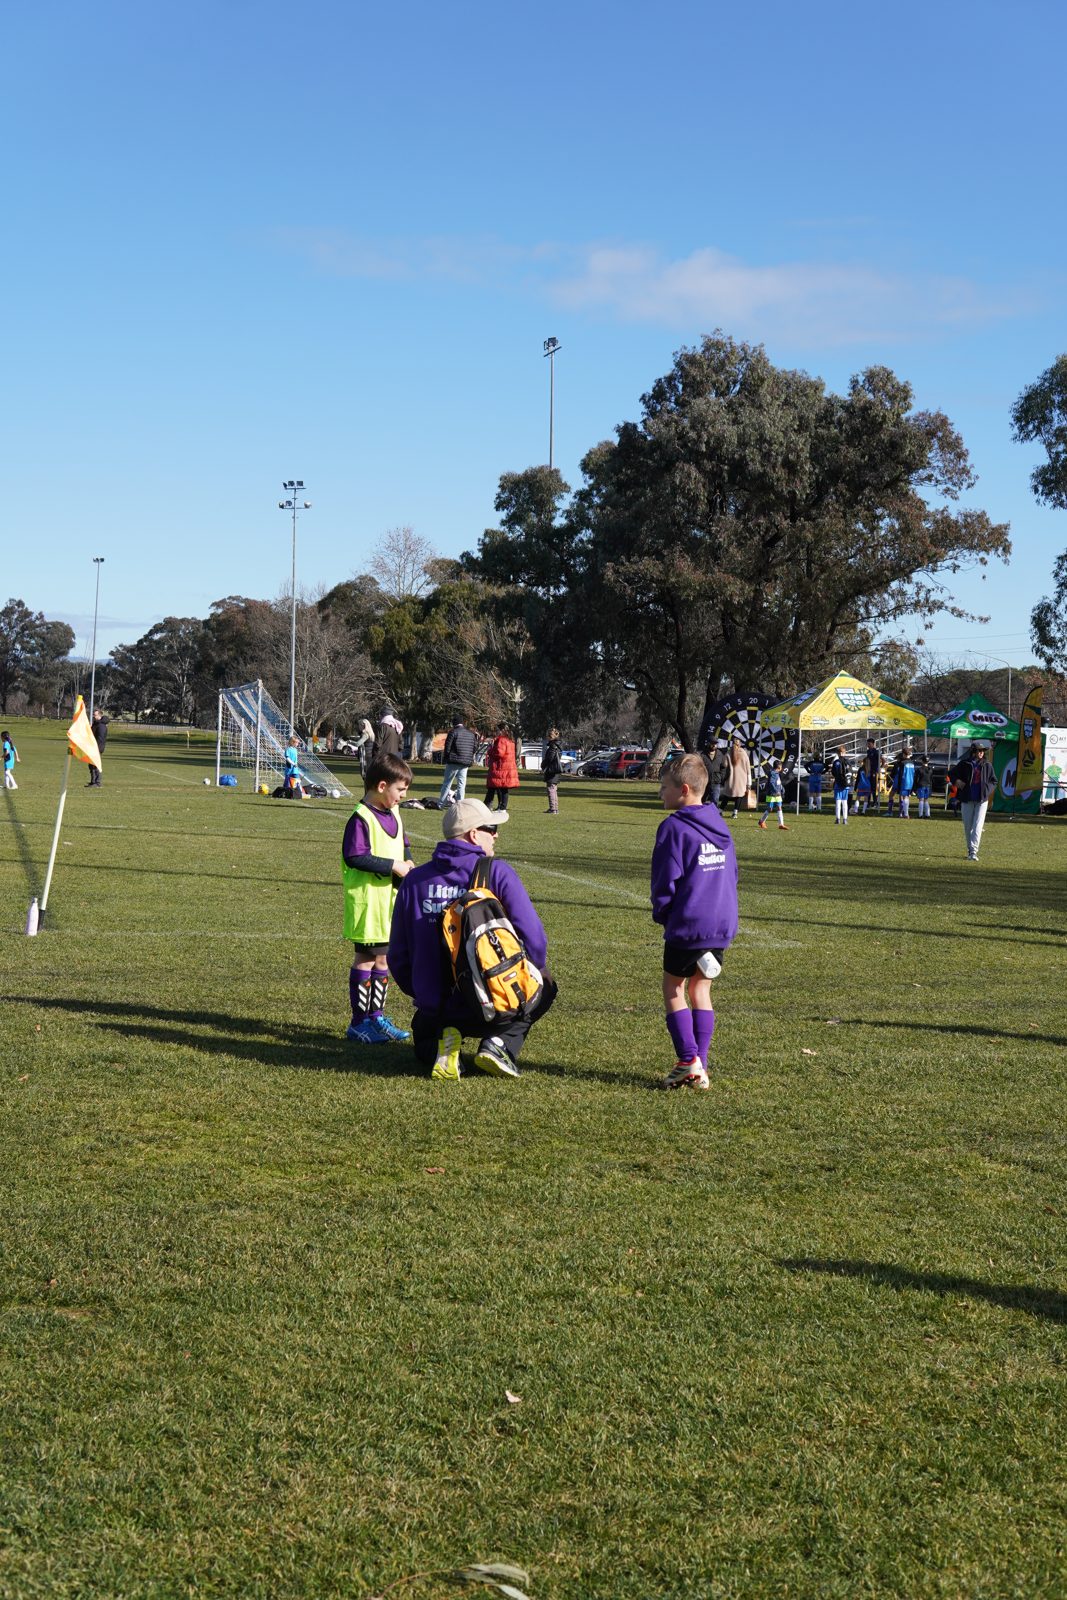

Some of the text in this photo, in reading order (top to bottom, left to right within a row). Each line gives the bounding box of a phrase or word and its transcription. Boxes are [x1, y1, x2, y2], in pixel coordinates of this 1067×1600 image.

[723, 702, 732, 711] 12
[972, 714, 1005, 724] MILO
[788, 754, 795, 762] 10
